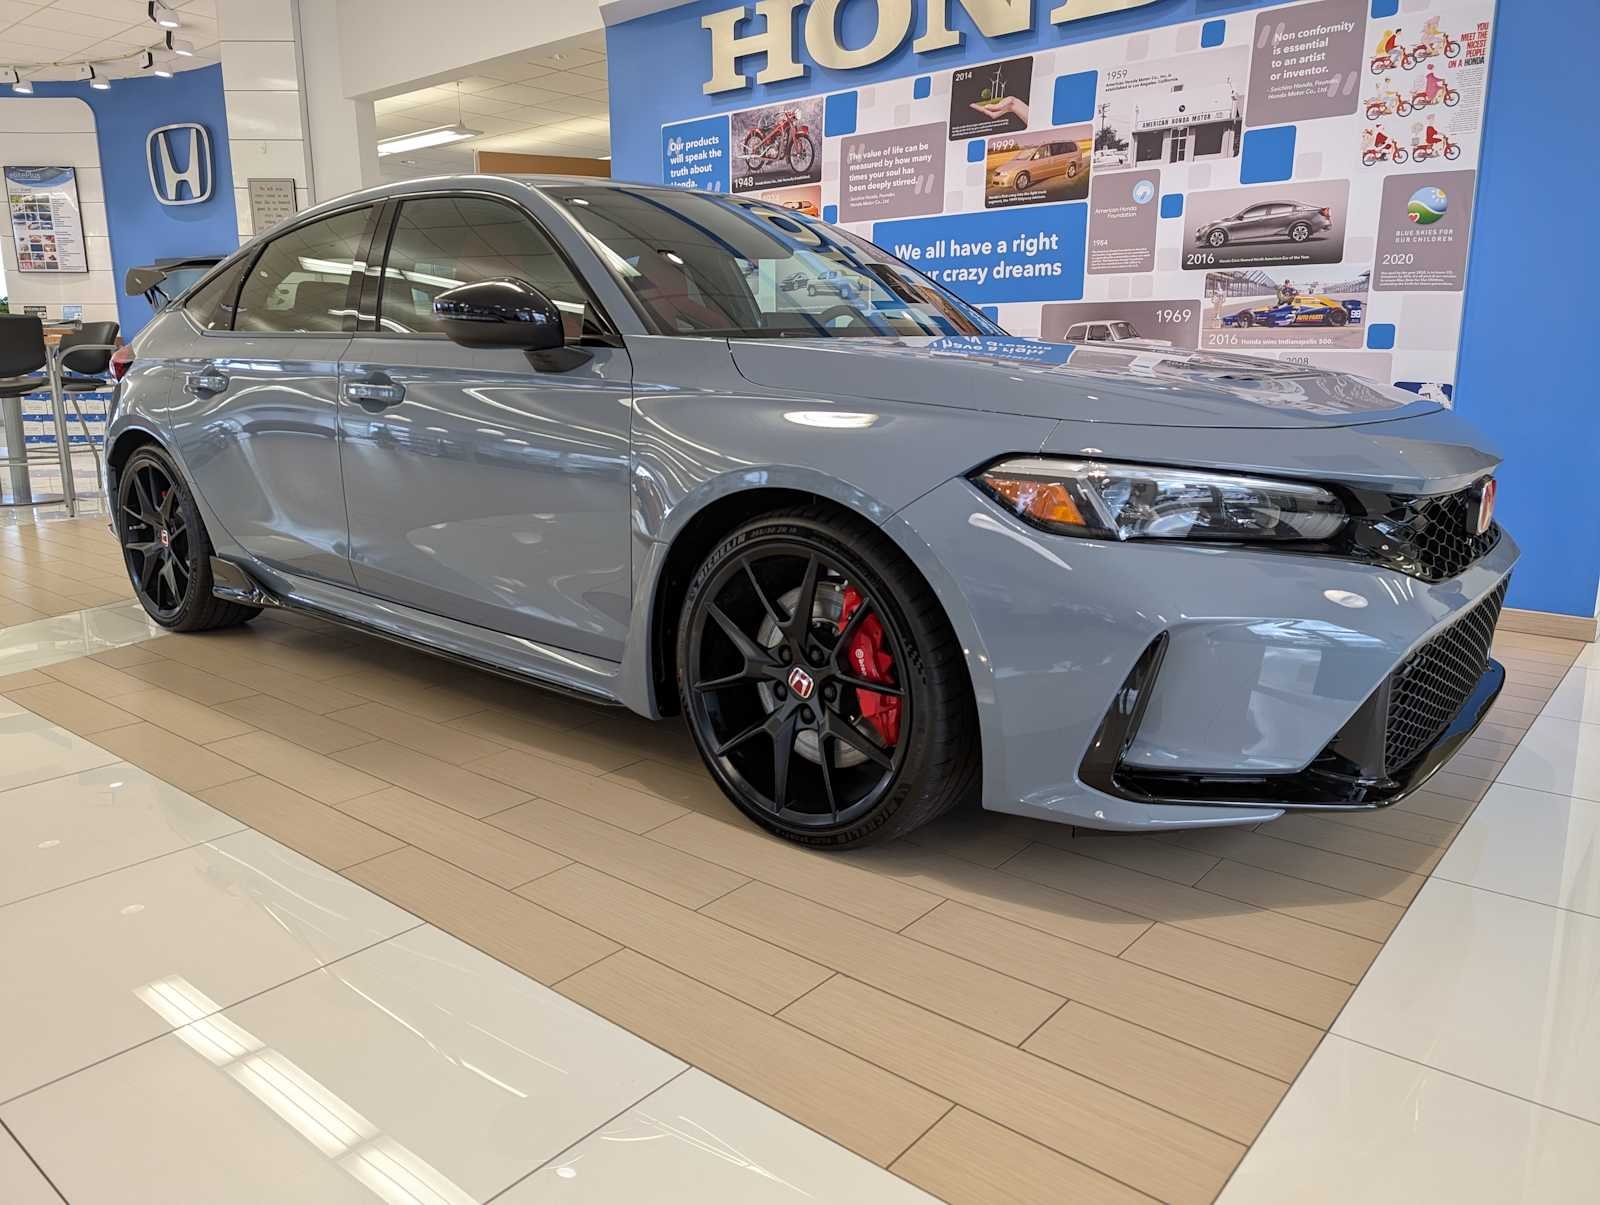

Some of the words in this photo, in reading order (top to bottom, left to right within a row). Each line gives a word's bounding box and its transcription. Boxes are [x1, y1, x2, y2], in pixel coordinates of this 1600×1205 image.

[1274, 32, 1296, 42] Non
[1297, 20, 1355, 38] conformity
[1477, 22, 1489, 30] YOU
[1461, 32, 1476, 41] MEET
[1478, 31, 1488, 39] THE
[1272, 46, 1281, 56] is
[1283, 37, 1329, 54] essential
[1466, 48, 1486, 58] PEOPLE
[1271, 60, 1282, 68] to
[1284, 58, 1296, 66] an
[1298, 52, 1326, 64] artist
[1448, 60, 1456, 68] ON
[1464, 56, 1484, 66] HONDA
[956, 71, 972, 82] 2014
[1106, 69, 1128, 80] 1959
[1270, 72, 1282, 81] or
[1283, 65, 1329, 79] inventor.
[670, 142, 684, 151] Our
[686, 136, 720, 152] products
[849, 152, 861, 160] The
[863, 150, 882, 159] value
[883, 146, 891, 155] of
[892, 146, 904, 154] life
[919, 142, 929, 150] be
[991, 139, 1015, 152] 1999
[670, 153, 684, 164] will
[685, 150, 708, 164] speak
[709, 148, 722, 158] the
[849, 159, 883, 171] measured
[884, 158, 893, 168] by
[894, 157, 911, 165] how
[912, 154, 932, 163] many
[670, 166, 688, 178] truth
[690, 163, 712, 174] about
[849, 174, 868, 182] times
[869, 171, 885, 181] your
[886, 168, 901, 177] soul
[902, 167, 914, 175] has
[734, 176, 754, 188] 1948
[868, 180, 891, 190] deeply
[892, 176, 918, 187] stirred.
[895, 243, 921, 261] We
[925, 240, 945, 259] all
[950, 240, 992, 258] have
[996, 241, 1008, 254] a
[1012, 232, 1059, 256] right
[1187, 254, 1215, 265] 2016
[1382, 254, 1414, 265] 2020
[942, 266, 988, 285] crazy
[992, 260, 1062, 280] dreams
[1156, 309, 1192, 323] 1969
[1208, 334, 1238, 345] 2016
